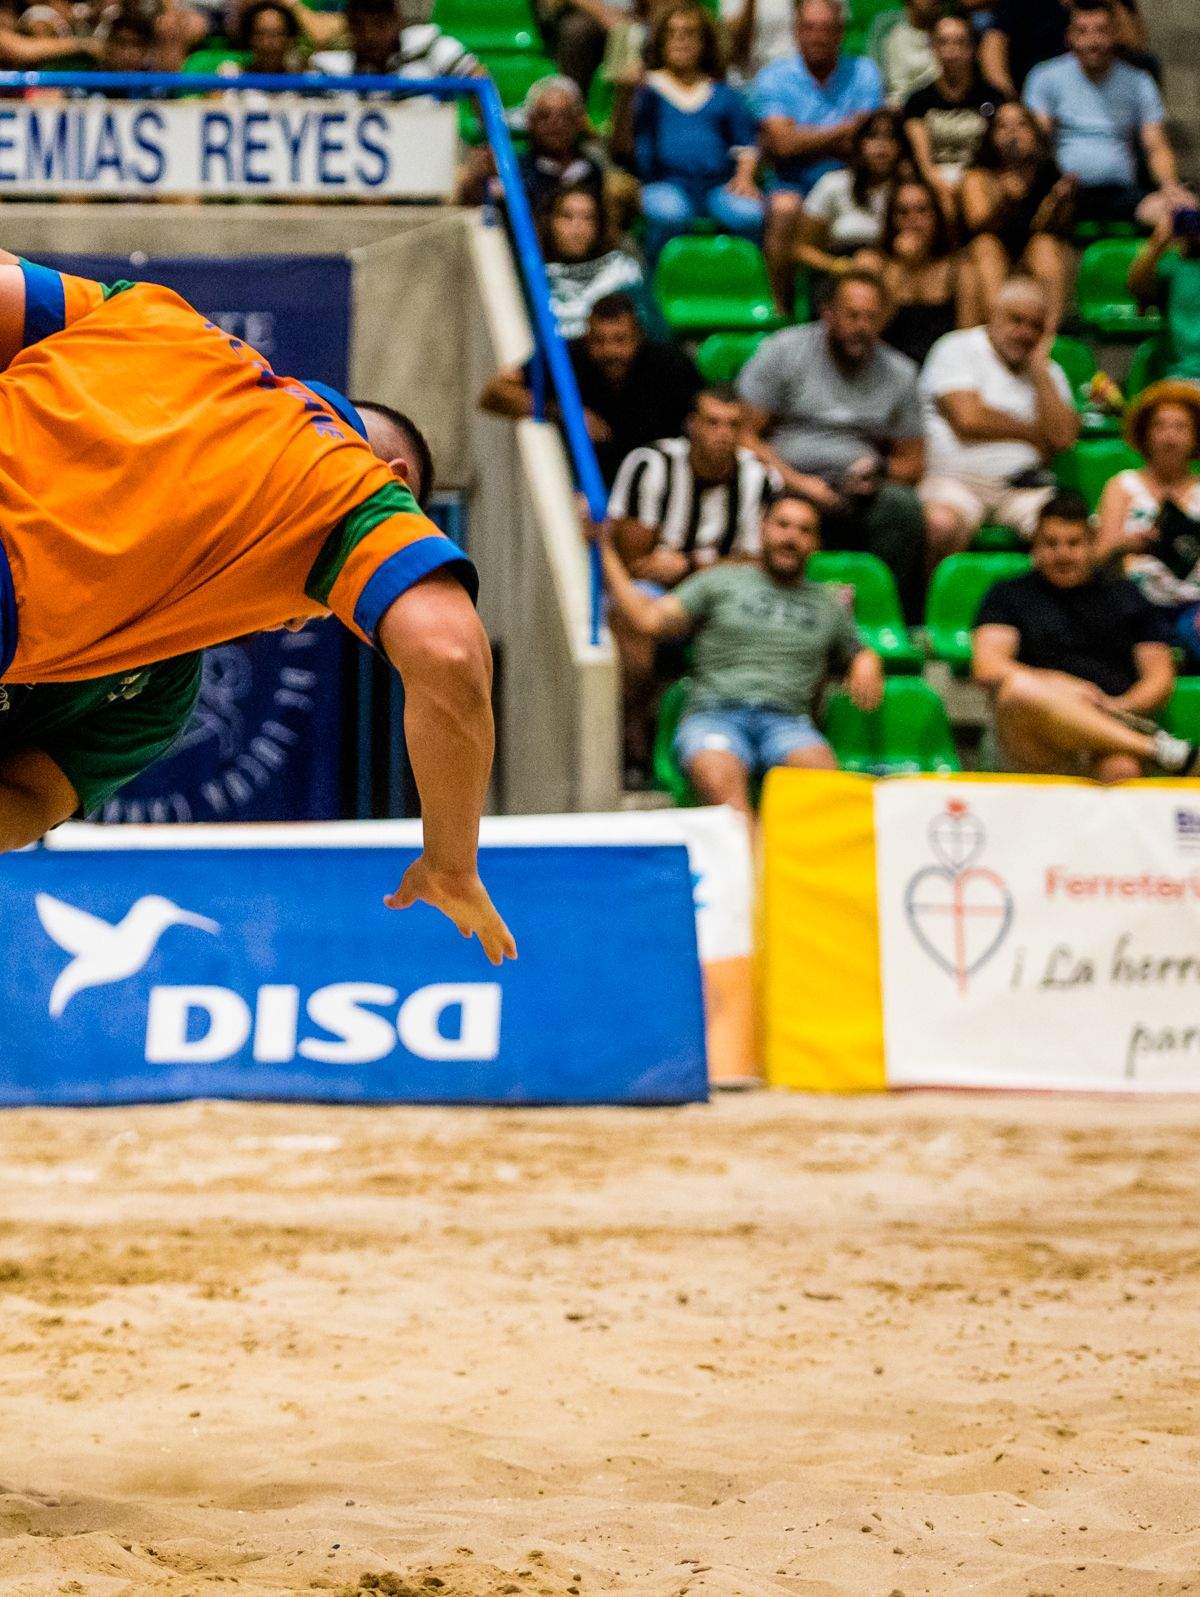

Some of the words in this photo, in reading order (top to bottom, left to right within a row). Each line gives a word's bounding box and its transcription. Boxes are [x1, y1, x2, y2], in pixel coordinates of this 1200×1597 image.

[201, 110, 389, 186] REYES
[1110, 932, 1200, 985] herr
[145, 982, 502, 1063] DISA
